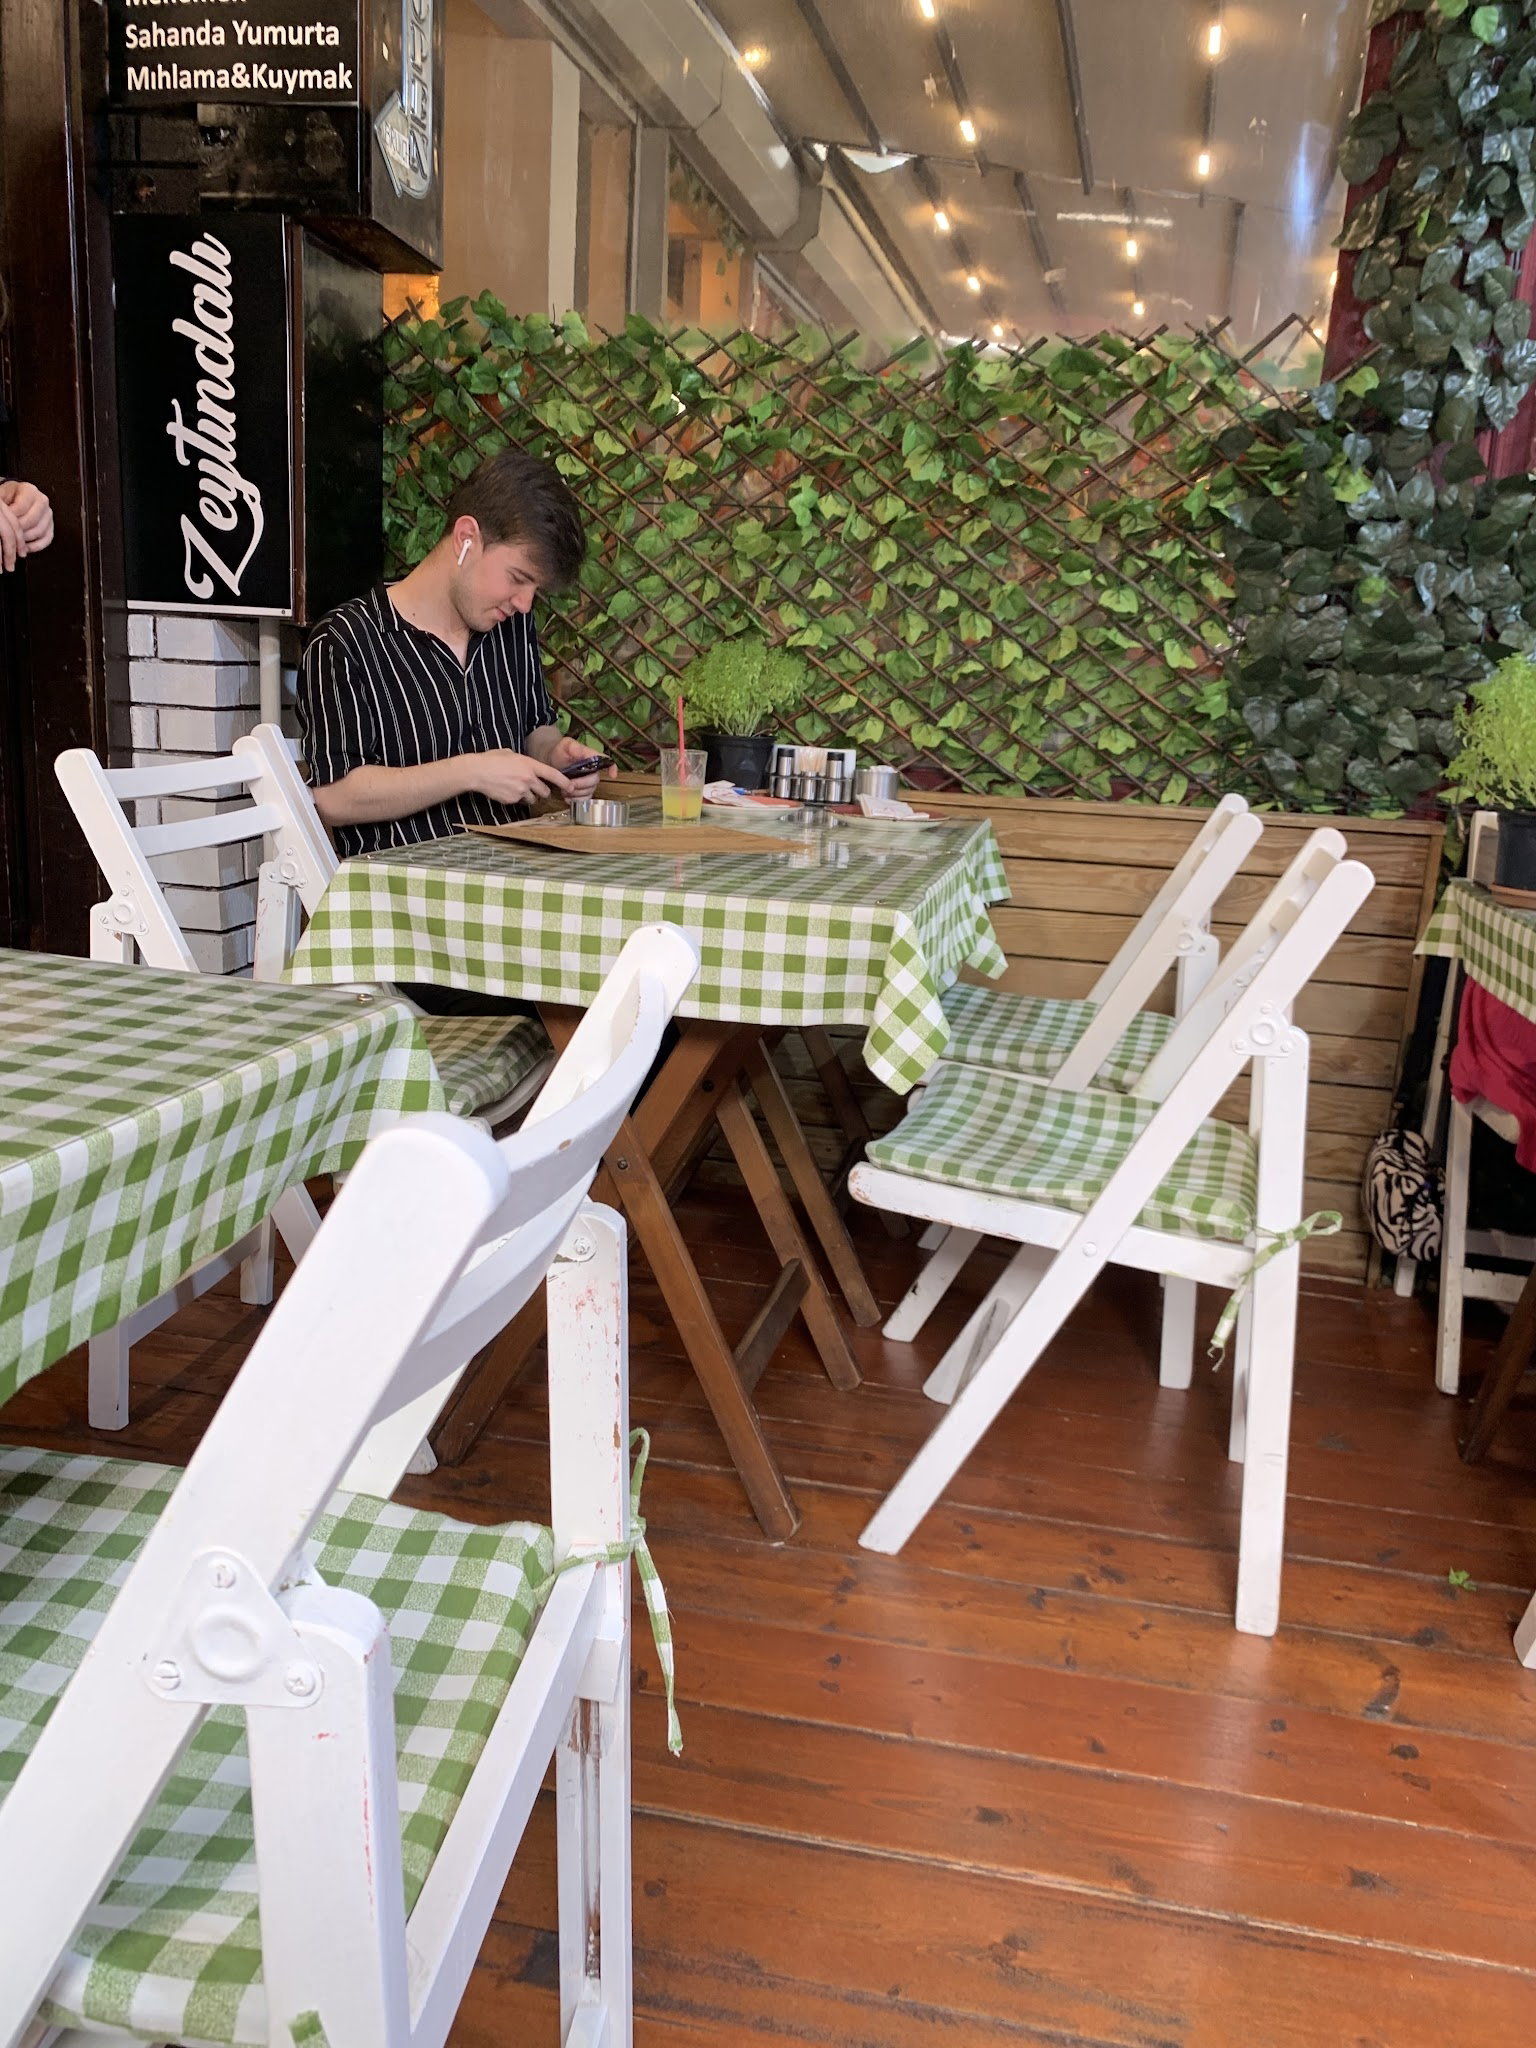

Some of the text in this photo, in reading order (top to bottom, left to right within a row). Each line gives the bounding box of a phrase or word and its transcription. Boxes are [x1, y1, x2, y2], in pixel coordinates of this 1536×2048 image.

[125, 18, 340, 48] Sahanda Yumurta
[127, 61, 353, 94] Mıhlama&Kuymak
